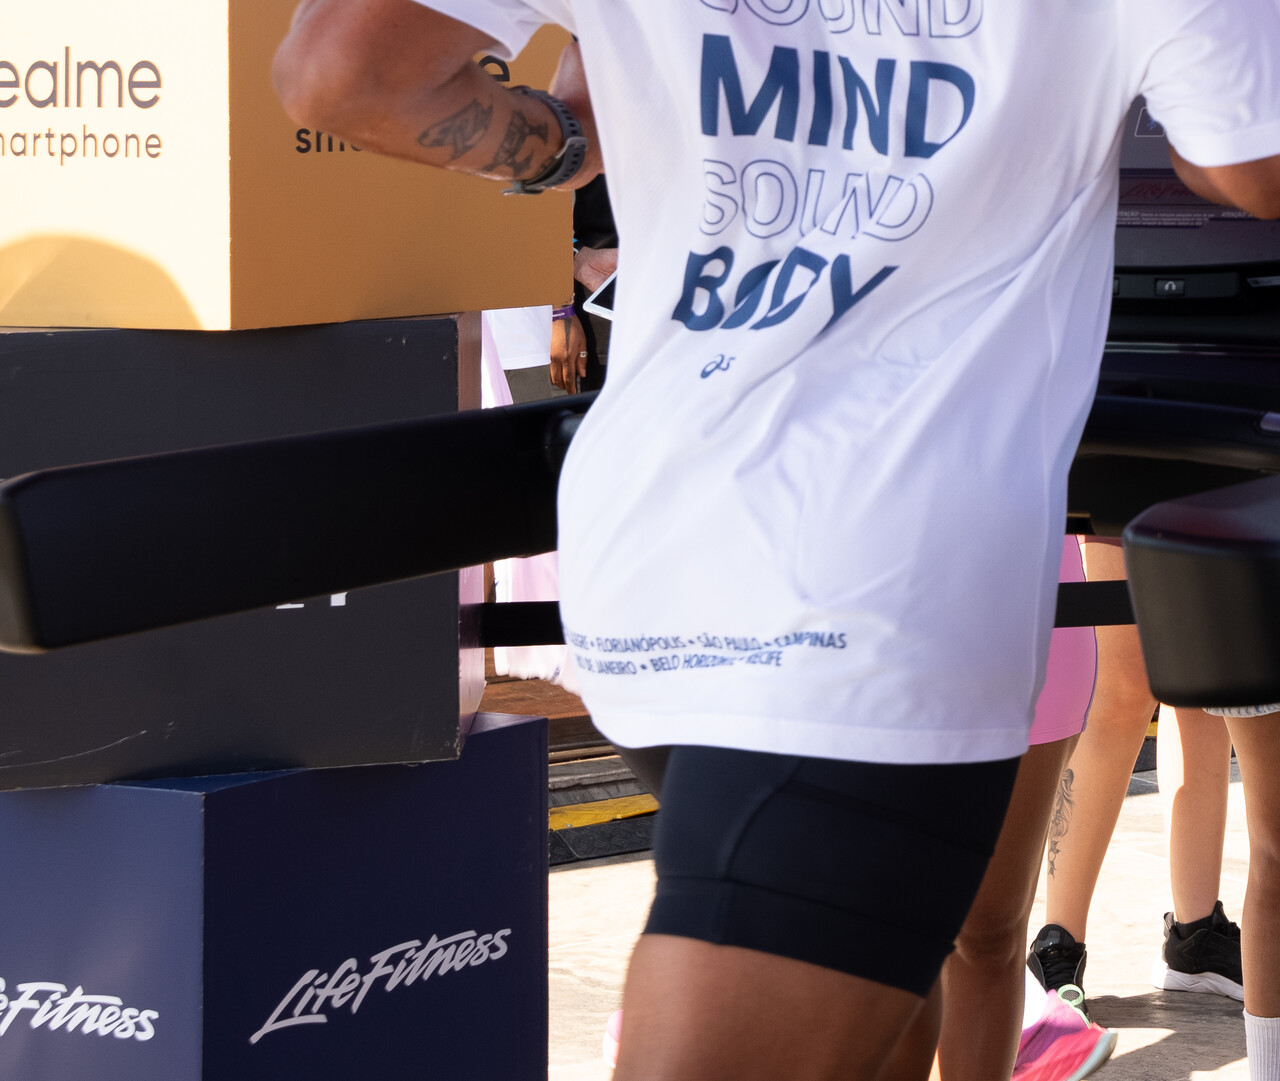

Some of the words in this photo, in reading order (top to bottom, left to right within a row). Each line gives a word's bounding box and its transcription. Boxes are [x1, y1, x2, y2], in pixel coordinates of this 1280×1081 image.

[0, 46, 162, 109] ealme
[700, 32, 977, 160] MIND
[0, 124, 162, 166] artphone
[650, 655, 680, 672] BELO
